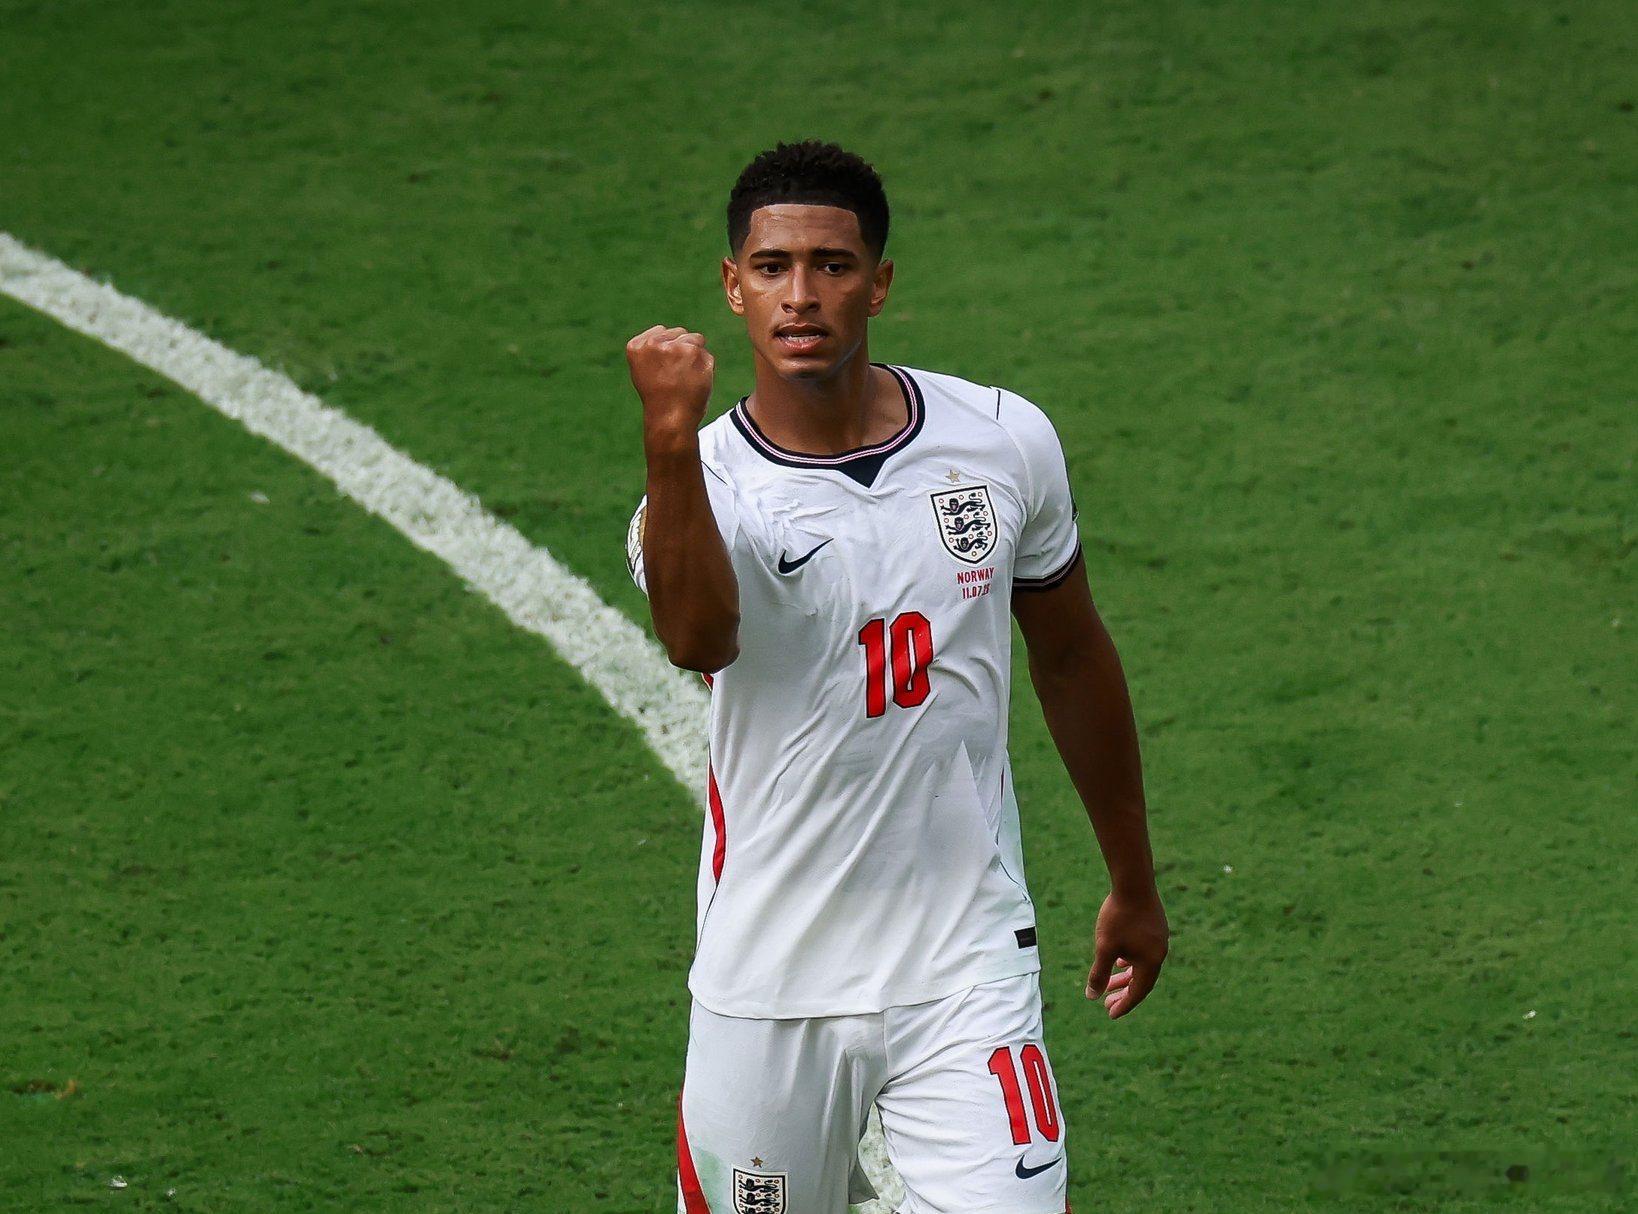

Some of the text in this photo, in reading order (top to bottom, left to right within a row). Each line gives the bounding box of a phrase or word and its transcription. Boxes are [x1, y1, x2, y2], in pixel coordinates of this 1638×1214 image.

[956, 567, 995, 584] NORWAY
[858, 612, 933, 718] 10
[987, 1044, 1060, 1145] 10
